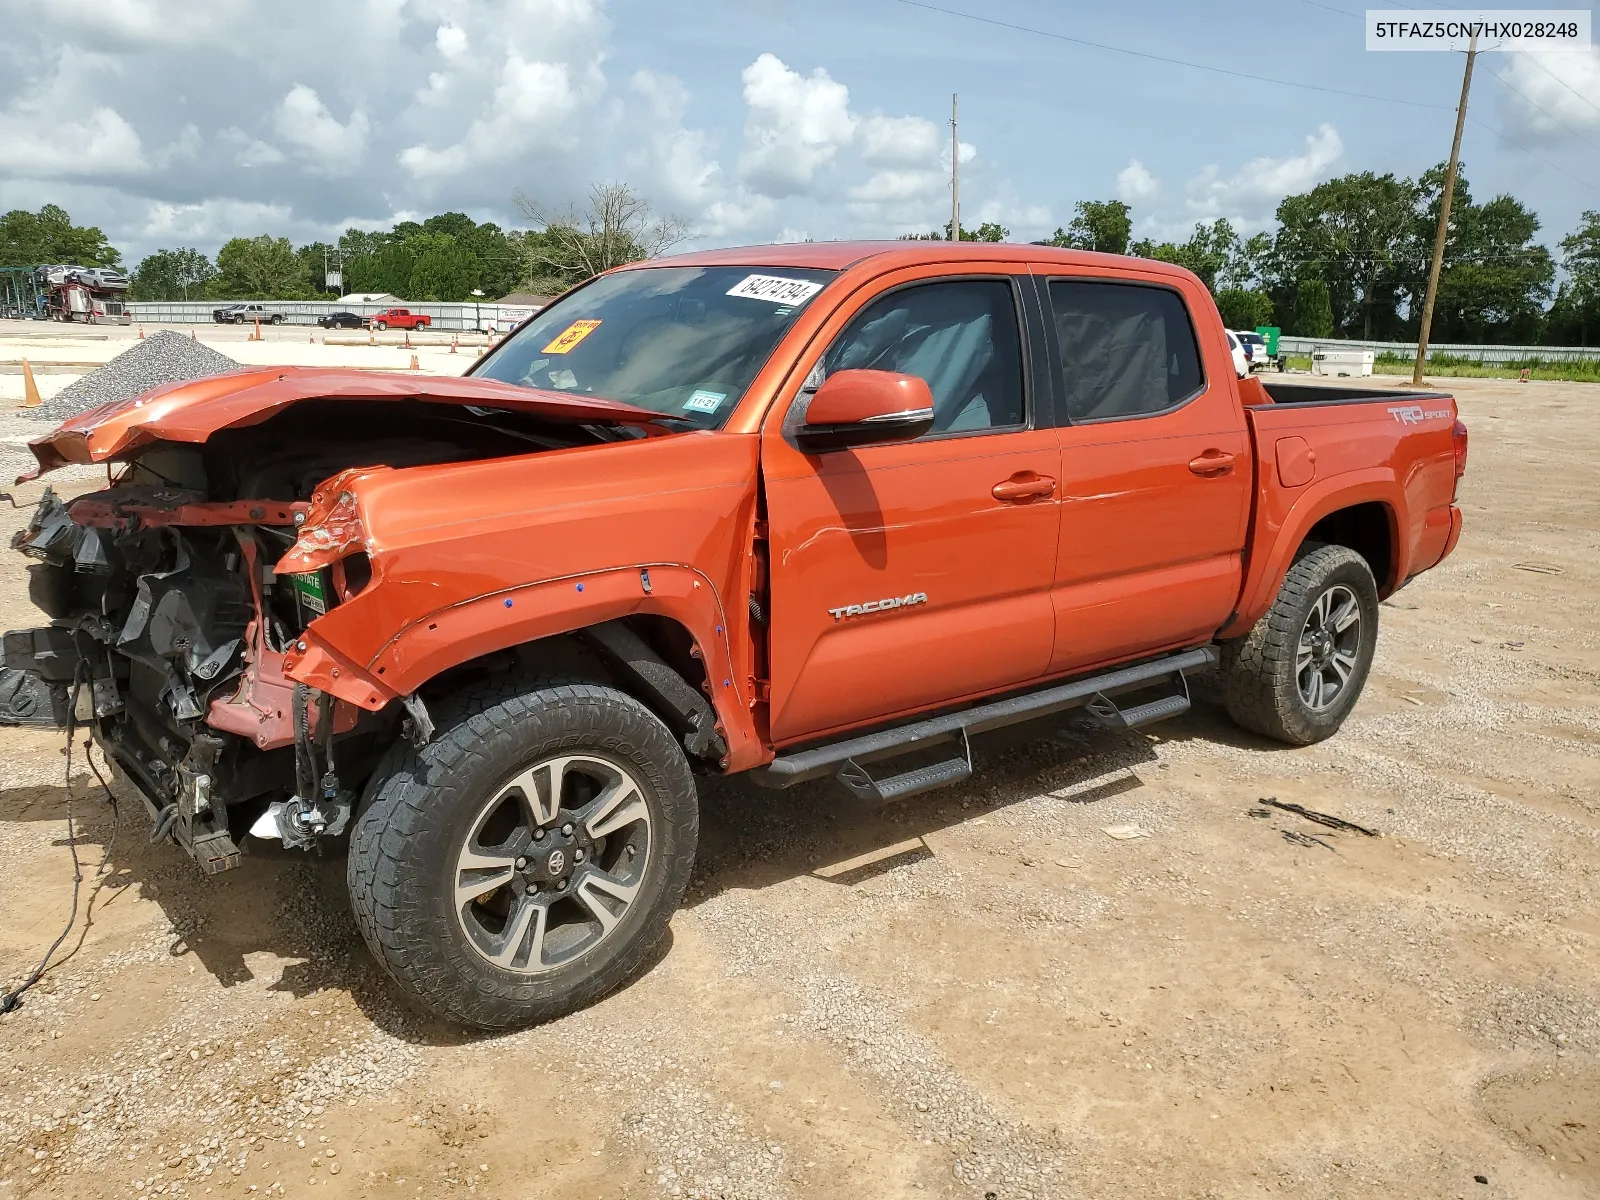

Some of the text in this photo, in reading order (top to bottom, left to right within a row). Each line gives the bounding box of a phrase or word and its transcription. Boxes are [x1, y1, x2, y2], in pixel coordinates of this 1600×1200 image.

[1387, 406, 1451, 425] TRD SPORT
[828, 592, 928, 618] TACOMA
